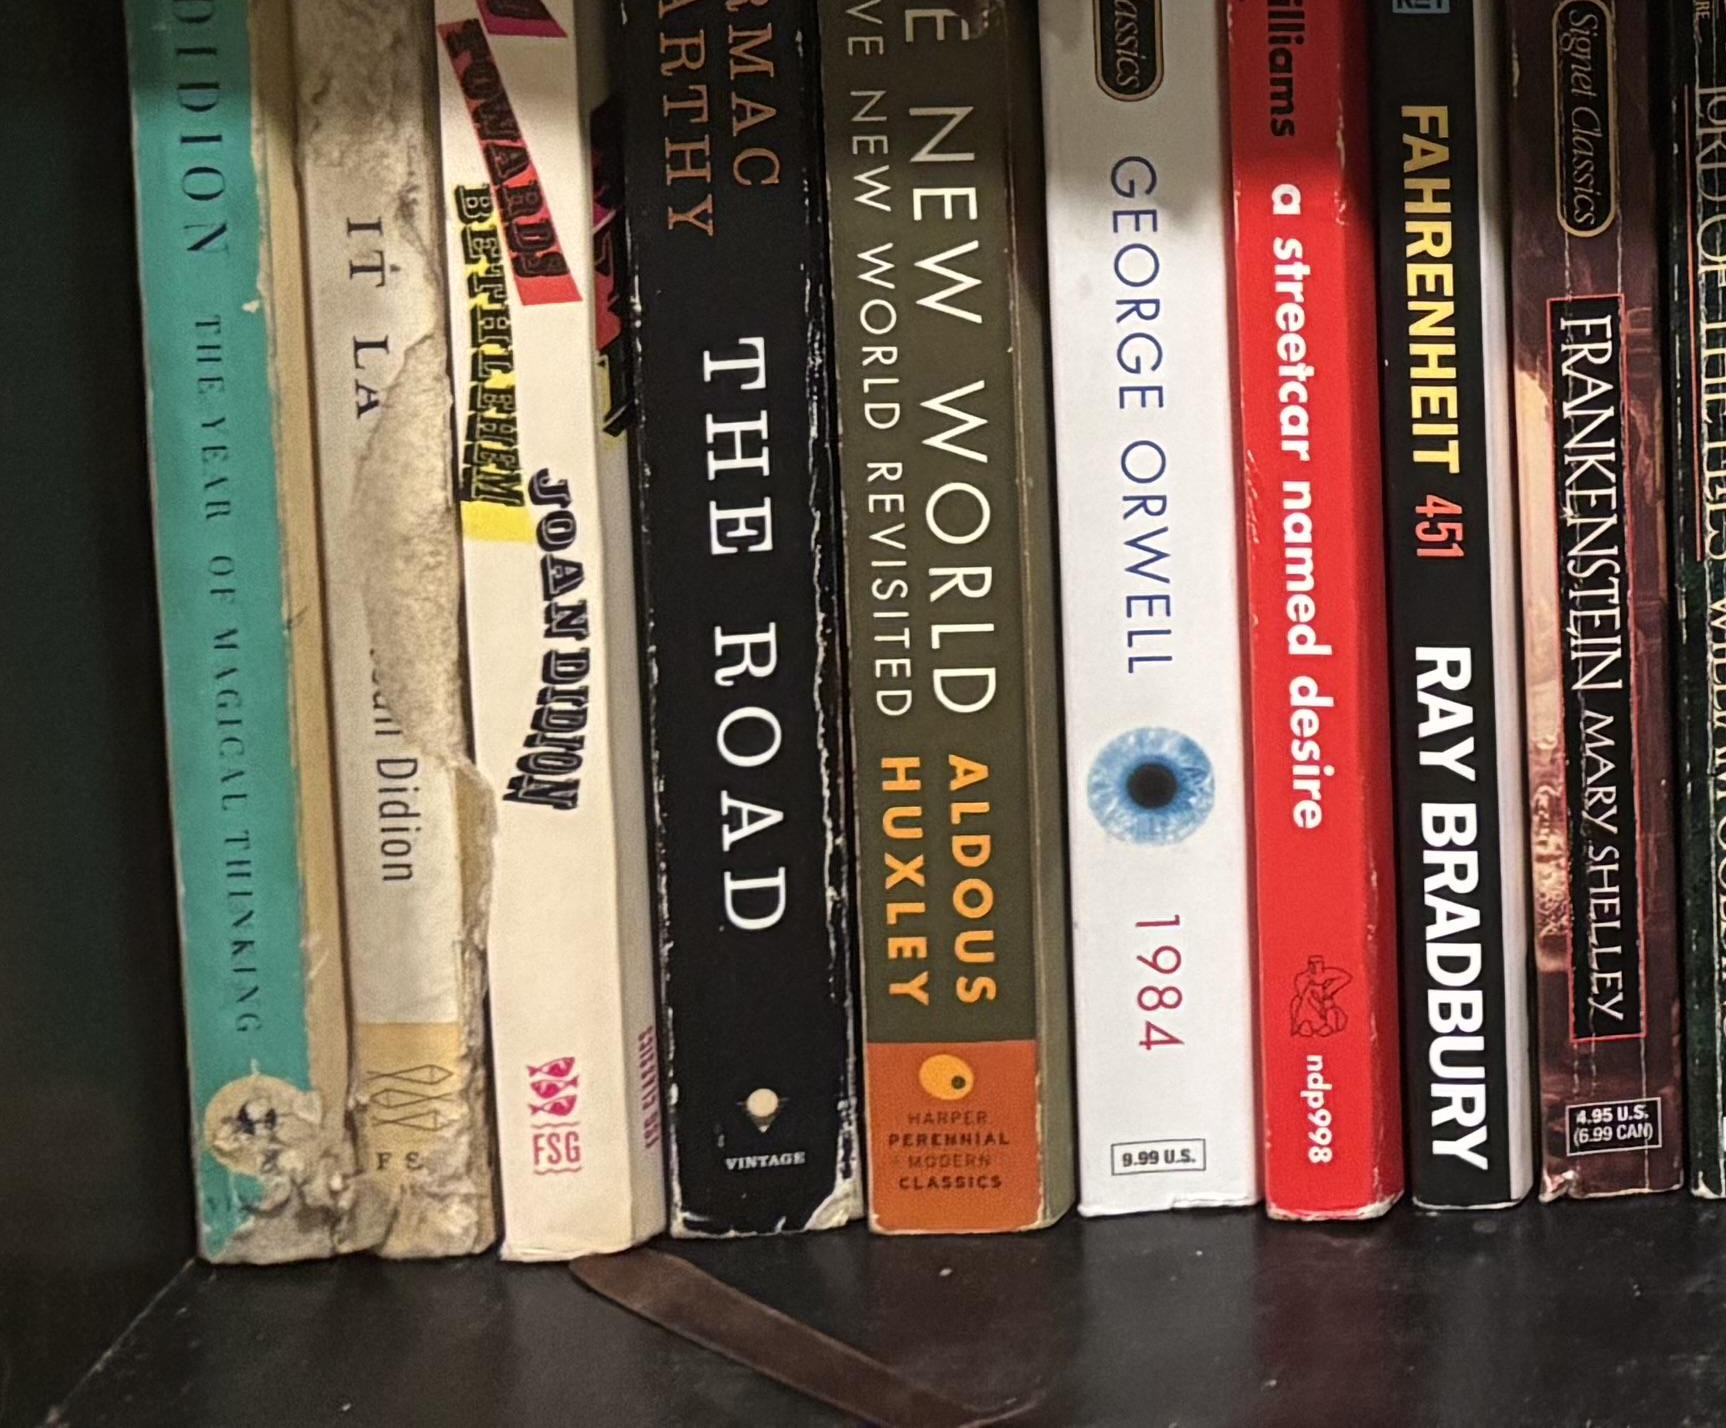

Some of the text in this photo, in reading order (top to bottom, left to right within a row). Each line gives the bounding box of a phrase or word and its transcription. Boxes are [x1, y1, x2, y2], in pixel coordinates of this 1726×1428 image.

[1271, 183, 1302, 215] a
[1110, 155, 1173, 674] GEORGE ORWELL
[1272, 237, 1315, 462] streetcar
[1401, 105, 1465, 558] FAHRENHEIT 451
[702, 335, 787, 931] THE ROAD
[1282, 480, 1333, 656] named
[1288, 675, 1332, 829] desire
[880, 756, 929, 1006] HUXLEY
[948, 754, 997, 1003] ALDOUS
[1414, 645, 1489, 1171] RAY BRADBURY
[1135, 914, 1184, 1051] 1984
[725, 1151, 806, 1171] VINTAGE
[1122, 1148, 1196, 1167] 9.99 U.S.
[1300, 1054, 1333, 1164] ndp998
